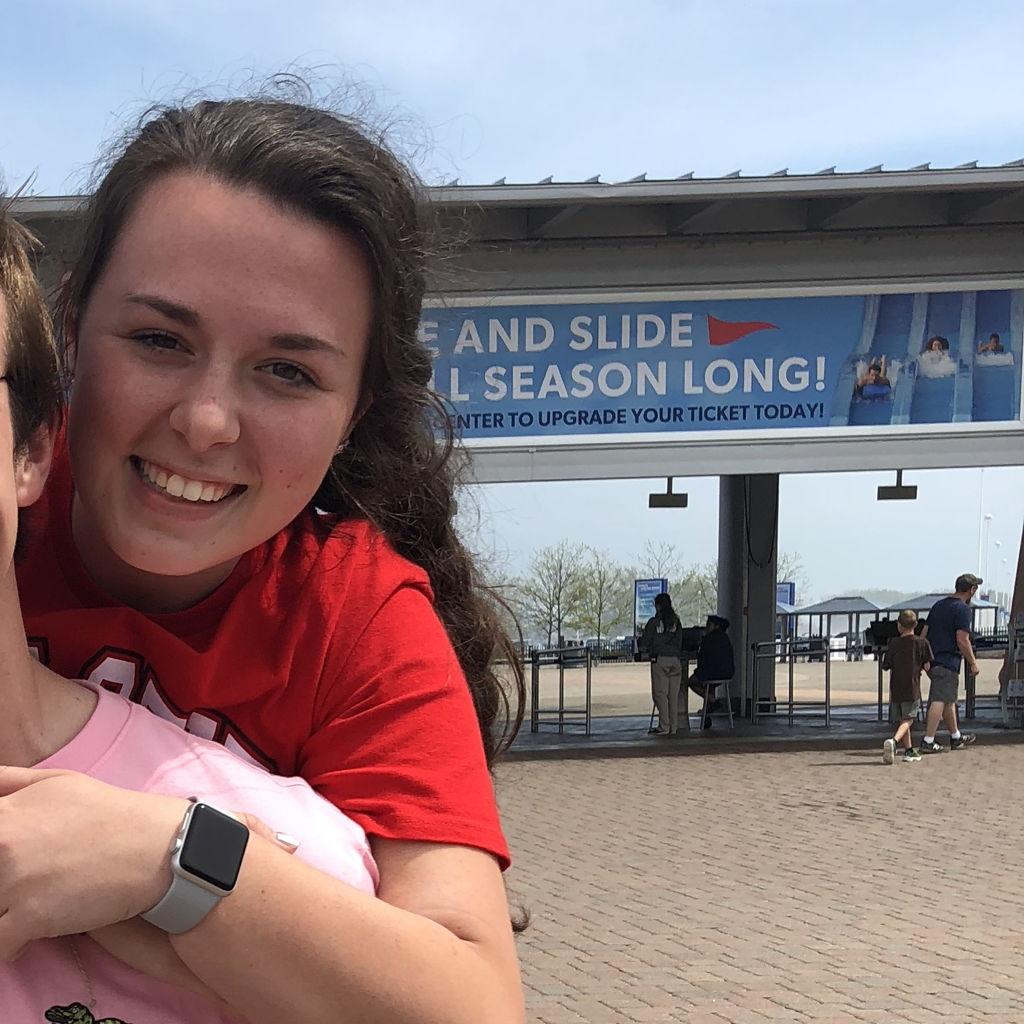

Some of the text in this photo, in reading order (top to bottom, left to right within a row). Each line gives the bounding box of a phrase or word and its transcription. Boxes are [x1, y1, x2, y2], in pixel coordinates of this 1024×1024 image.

[453, 317, 555, 354] AND
[569, 313, 693, 350] SLIDE
[484, 360, 667, 401] SEASON
[684, 356, 826, 395] LONG!
[508, 411, 534, 428] TO
[538, 409, 627, 427] UPGRADE
[631, 407, 684, 425] YOUR
[688, 405, 751, 422] TICKET
[754, 402, 824, 420] TODAY!
